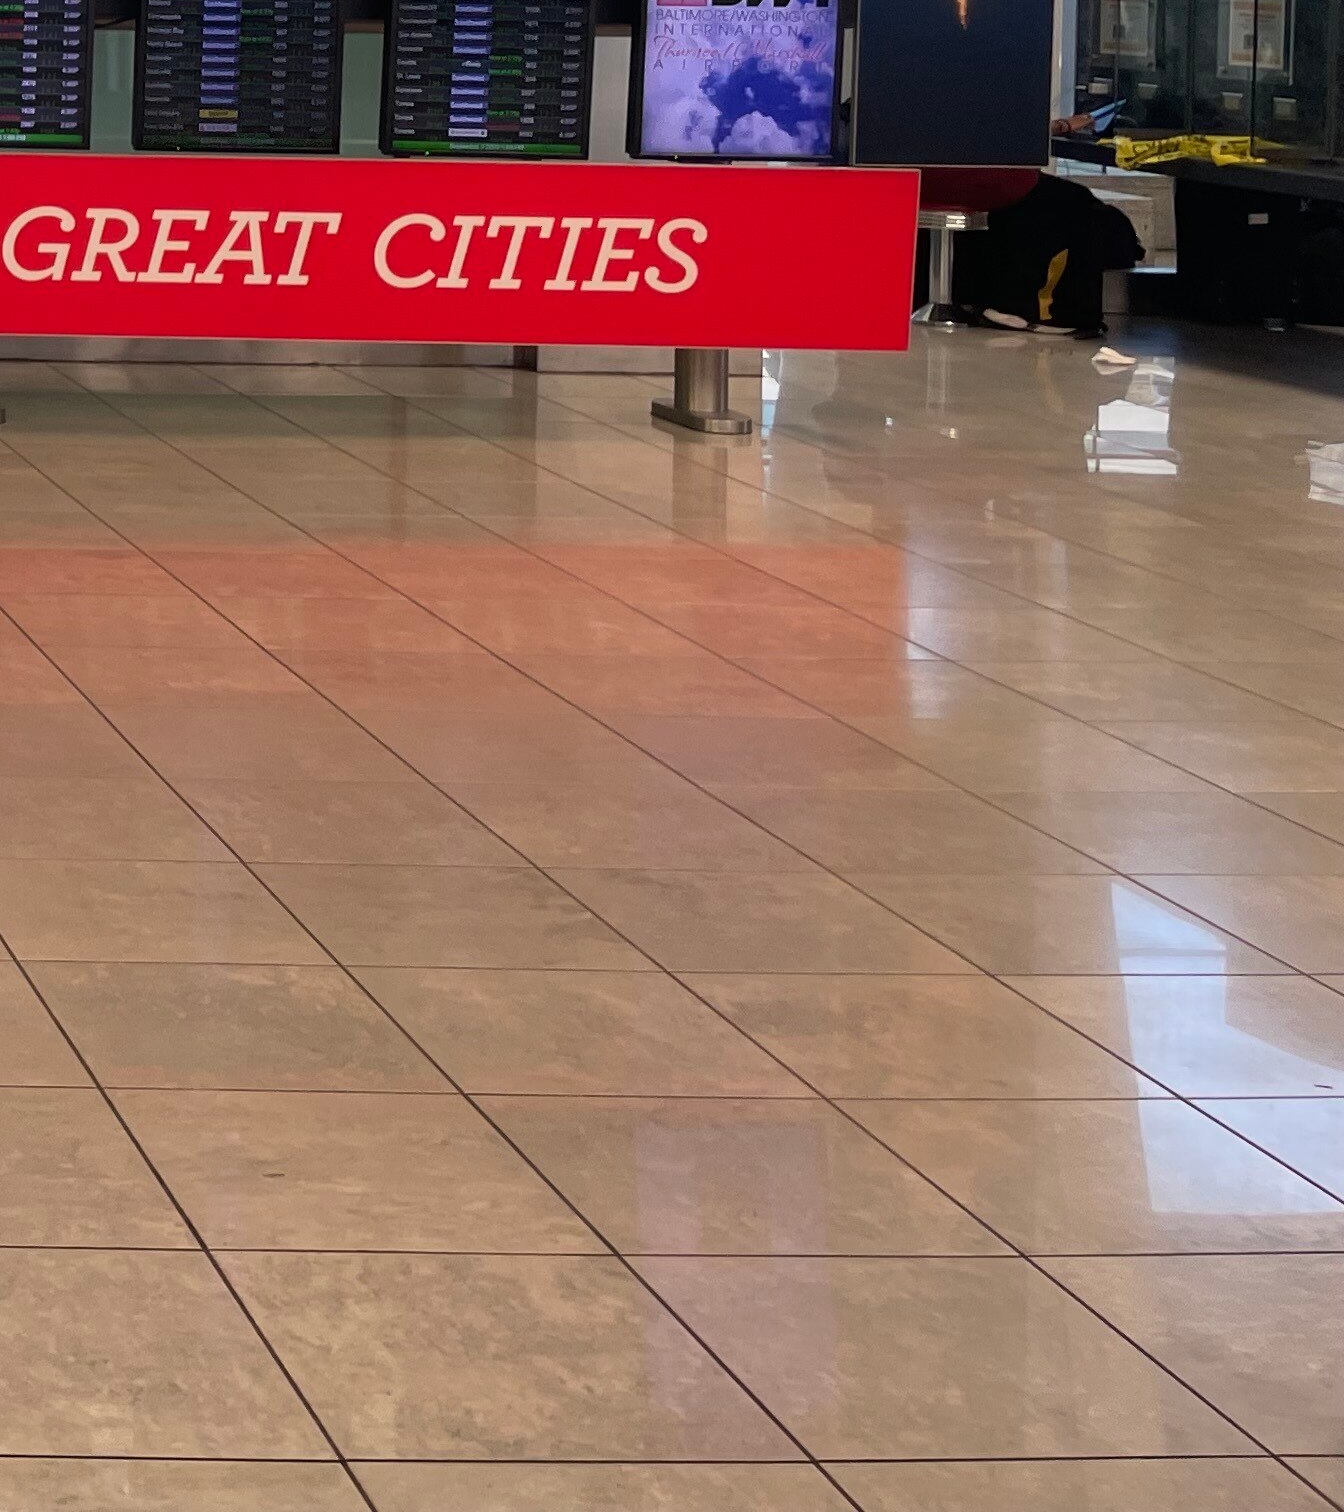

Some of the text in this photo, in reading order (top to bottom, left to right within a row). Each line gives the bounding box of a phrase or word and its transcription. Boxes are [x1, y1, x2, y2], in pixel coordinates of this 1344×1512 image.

[655, 9, 830, 23] BALTIMORE/WASHINGTON
[2, 205, 343, 286] GREAT
[374, 213, 708, 294] CITIES
